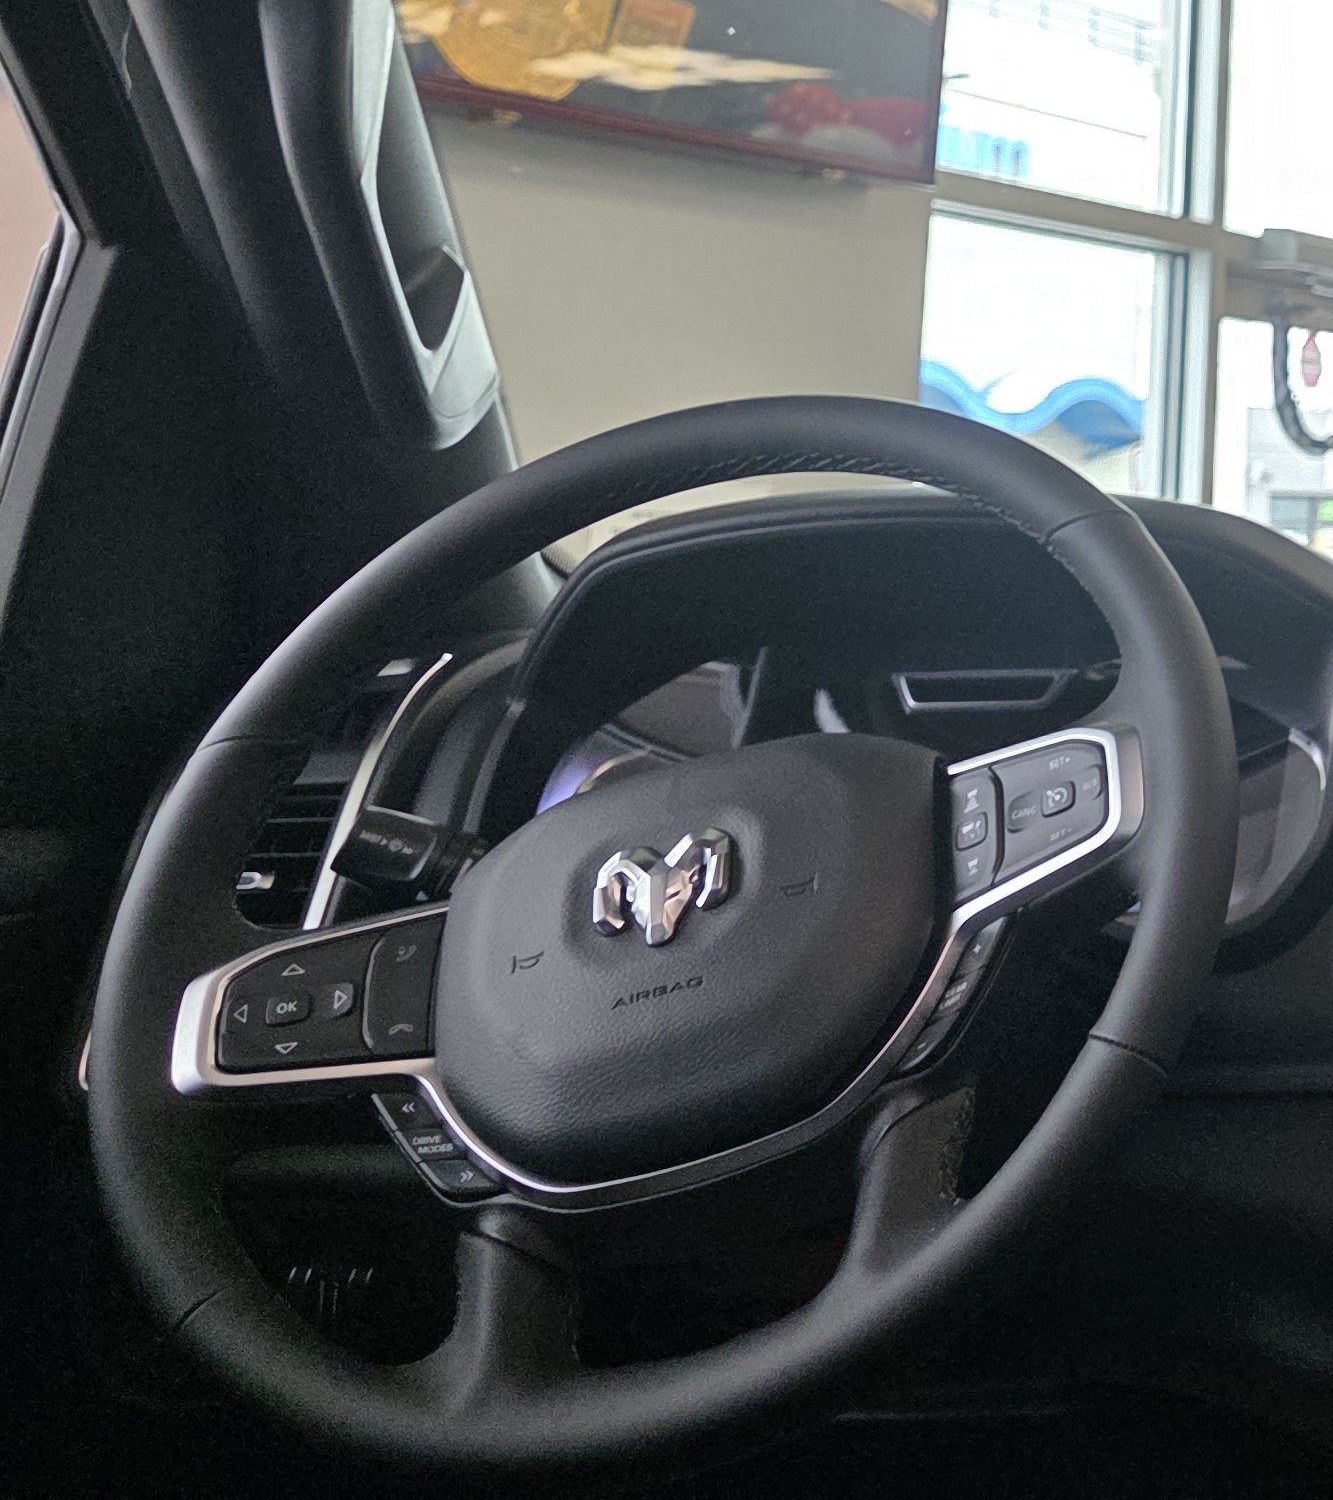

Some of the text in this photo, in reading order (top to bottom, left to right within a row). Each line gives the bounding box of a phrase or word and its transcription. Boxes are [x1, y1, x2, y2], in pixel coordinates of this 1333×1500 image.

[610, 976, 704, 1011] AIRBAG
[276, 1002, 297, 1014] OK
[411, 1134, 442, 1146] DRIVE
[417, 1143, 454, 1154] MODES
